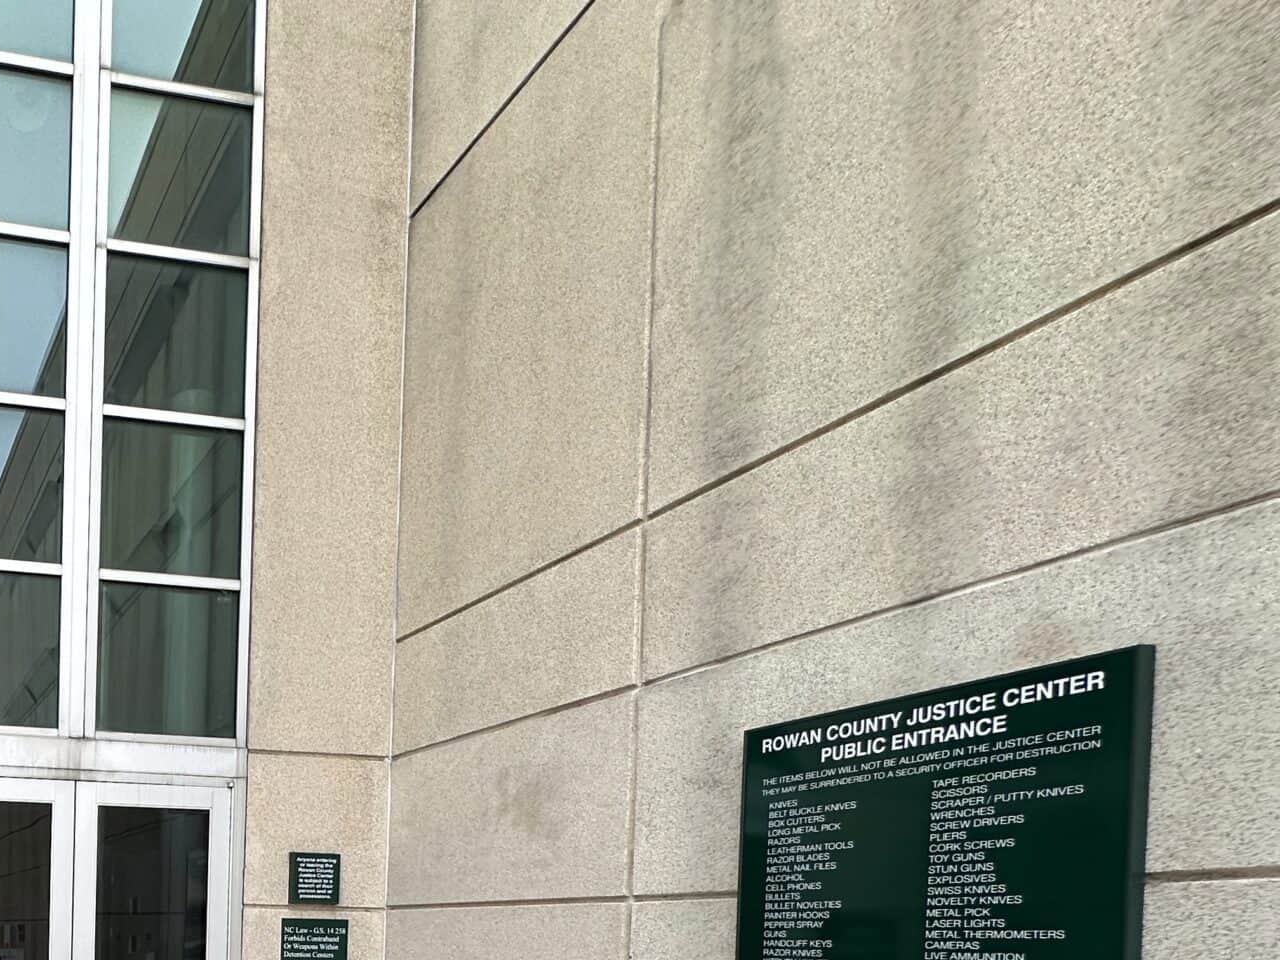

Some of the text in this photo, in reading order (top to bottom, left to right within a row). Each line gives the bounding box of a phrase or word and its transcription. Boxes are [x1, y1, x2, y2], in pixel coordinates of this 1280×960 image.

[761, 670, 1104, 753] ROWAN COUNTY JUSTICE CENTER
[820, 714, 1007, 762] PUBLIC ENTRANCE
[762, 724, 1101, 786] THE ITEMS BELOW WILL NOT BE ALLOWED IN THE JUSTICE CENTER
[761, 738, 1101, 796] THEY MAY BE SURRENDERED TO A SECURITY OFFICER FOR DESTRUCTION
[931, 766, 1036, 788] TAPE RECORDERS
[930, 784, 988, 799] SCISSORS
[930, 795, 984, 809] SCRAPER
[994, 789, 1033, 802] PUTTY
[1036, 784, 1084, 798] KNIVES
[768, 799, 797, 809] KNIVES
[768, 800, 856, 818] BELT BUCKLE KNIVES
[929, 805, 995, 820] WRENCHES
[768, 814, 826, 828] BOX CUTTERS
[929, 813, 1024, 831] SCREW DRIVERS
[767, 821, 841, 837] LONG METAL PICK
[767, 835, 800, 846] RAZORS
[929, 830, 967, 842] PLIERS
[767, 840, 854, 855] LEATHERMAN TOOLS
[928, 837, 1015, 852] CORK SCREWS
[766, 852, 830, 864] RAZOR BLADES
[928, 851, 985, 863] TOY GUNS
[766, 861, 836, 873] METAL NAIL FILES
[927, 861, 994, 874] STUN GUNS
[765, 873, 805, 882] ALCOHOL
[927, 873, 996, 884] EXPLOSIVES
[765, 881, 821, 891] CELL PHONES
[927, 884, 1006, 895] SWISS KNIVES
[765, 892, 802, 901] BULLETS
[926, 895, 1022, 905] NOVELTY KNIVES
[764, 900, 841, 909] BULLET NOVELTIES
[764, 910, 830, 919] PAINTER HOOKS
[925, 907, 990, 917] METAL PICK
[763, 920, 823, 928] PEPPER SPRAY
[925, 918, 1005, 927] LASER LIGHTS
[925, 930, 1065, 938] METAL THERMOMETERS
[763, 939, 832, 947] HANDCUFF KEYS
[924, 941, 980, 949] CAMERAS
[762, 948, 822, 957] RAZOR KNIVES
[924, 951, 1024, 960] LIVE AMMUNITION
